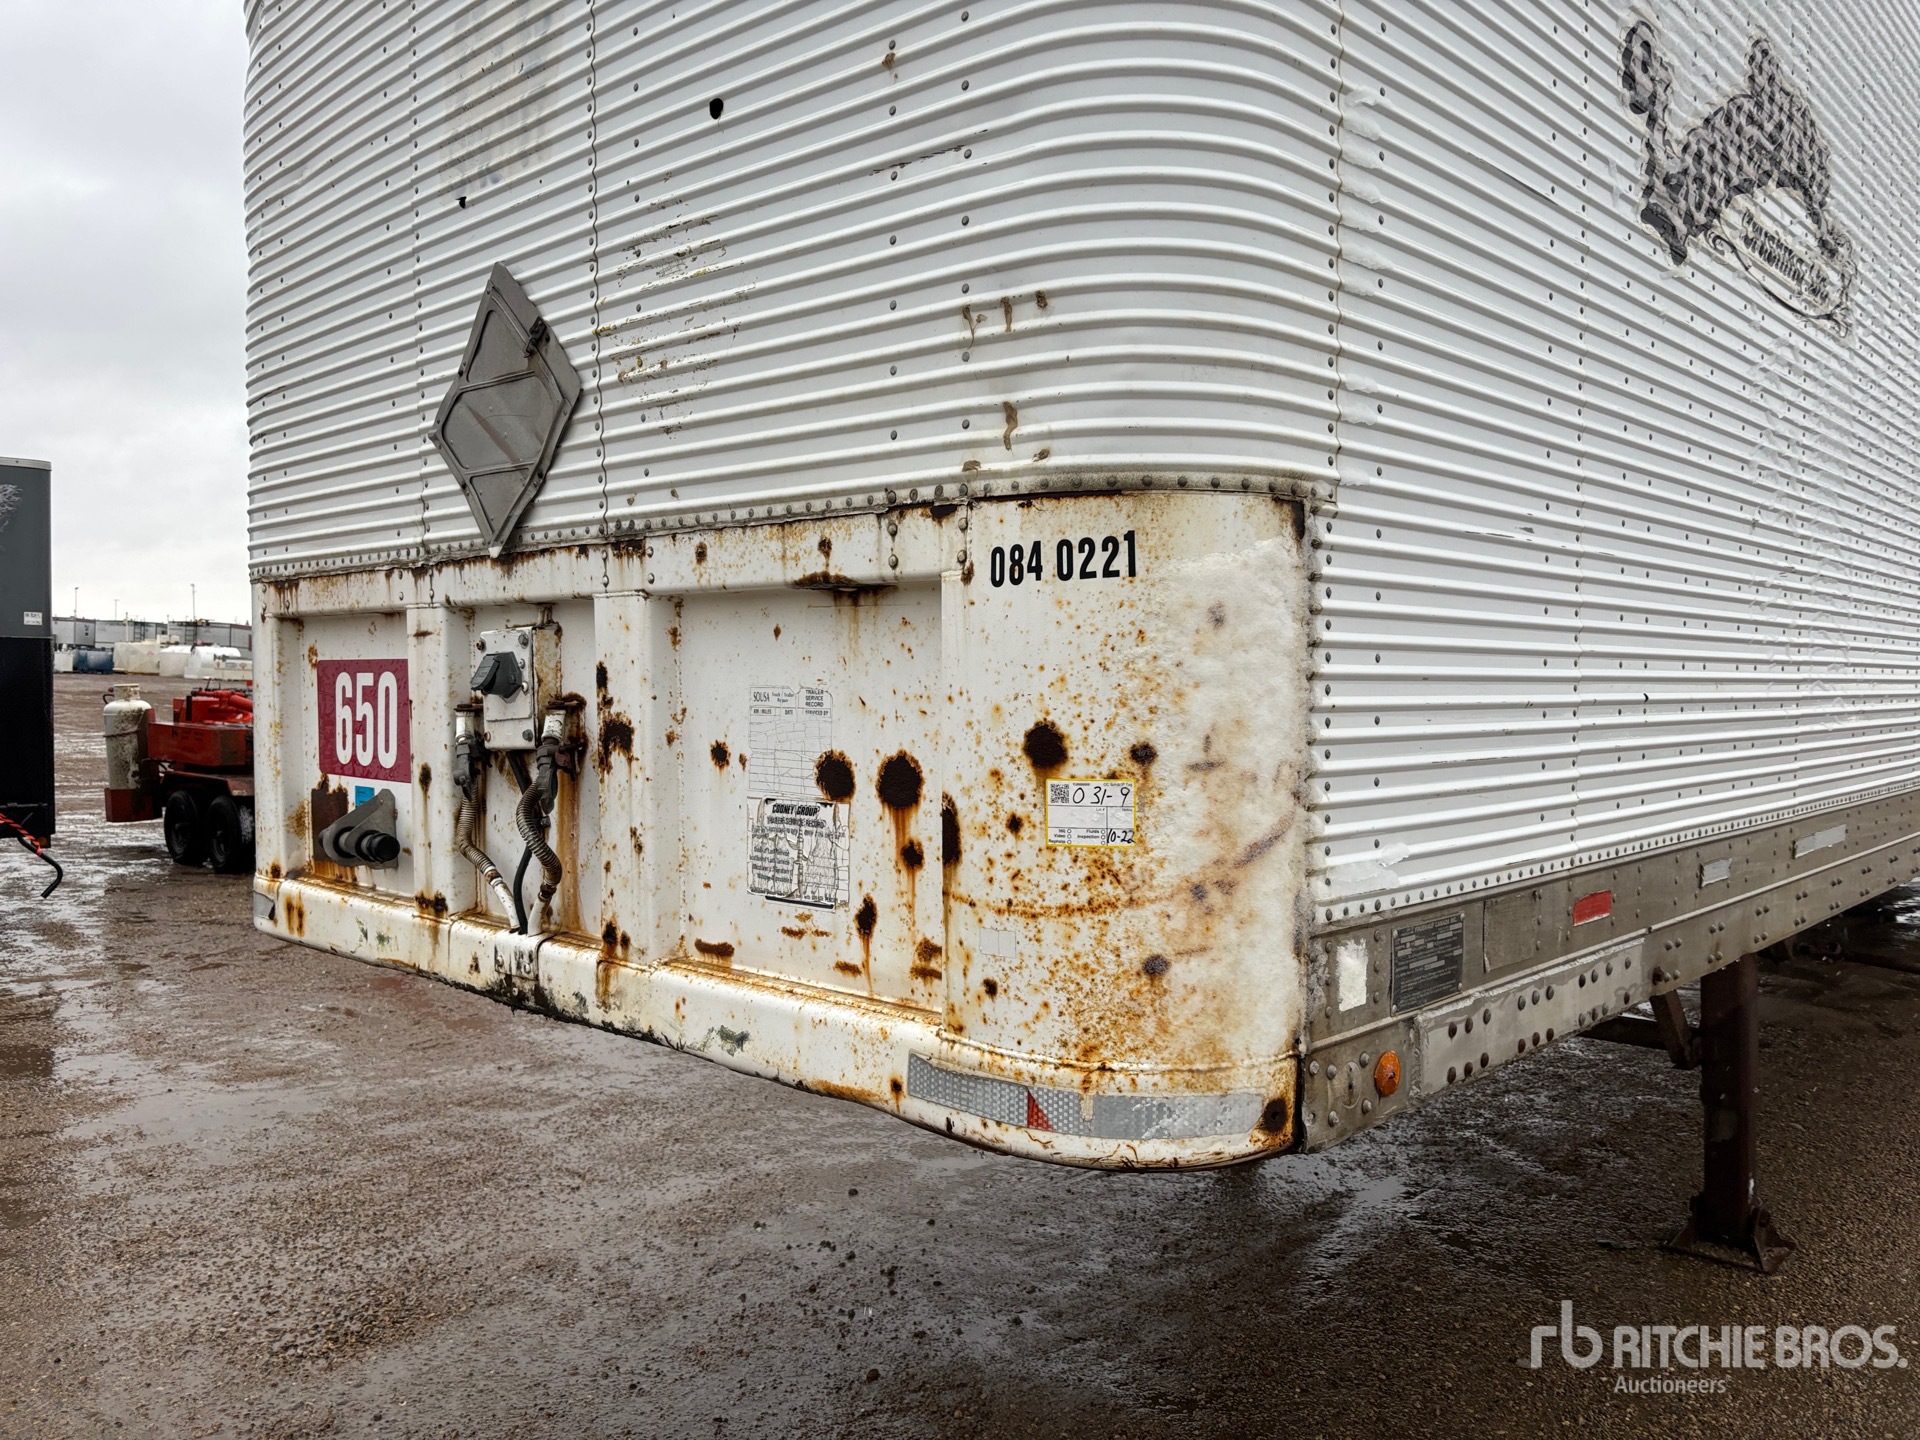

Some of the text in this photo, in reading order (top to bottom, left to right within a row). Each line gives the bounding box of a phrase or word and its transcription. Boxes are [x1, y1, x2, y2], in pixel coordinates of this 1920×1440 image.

[990, 530, 1137, 588] 084 0221
[335, 671, 398, 769] 650
[796, 804, 819, 816] GROUP
